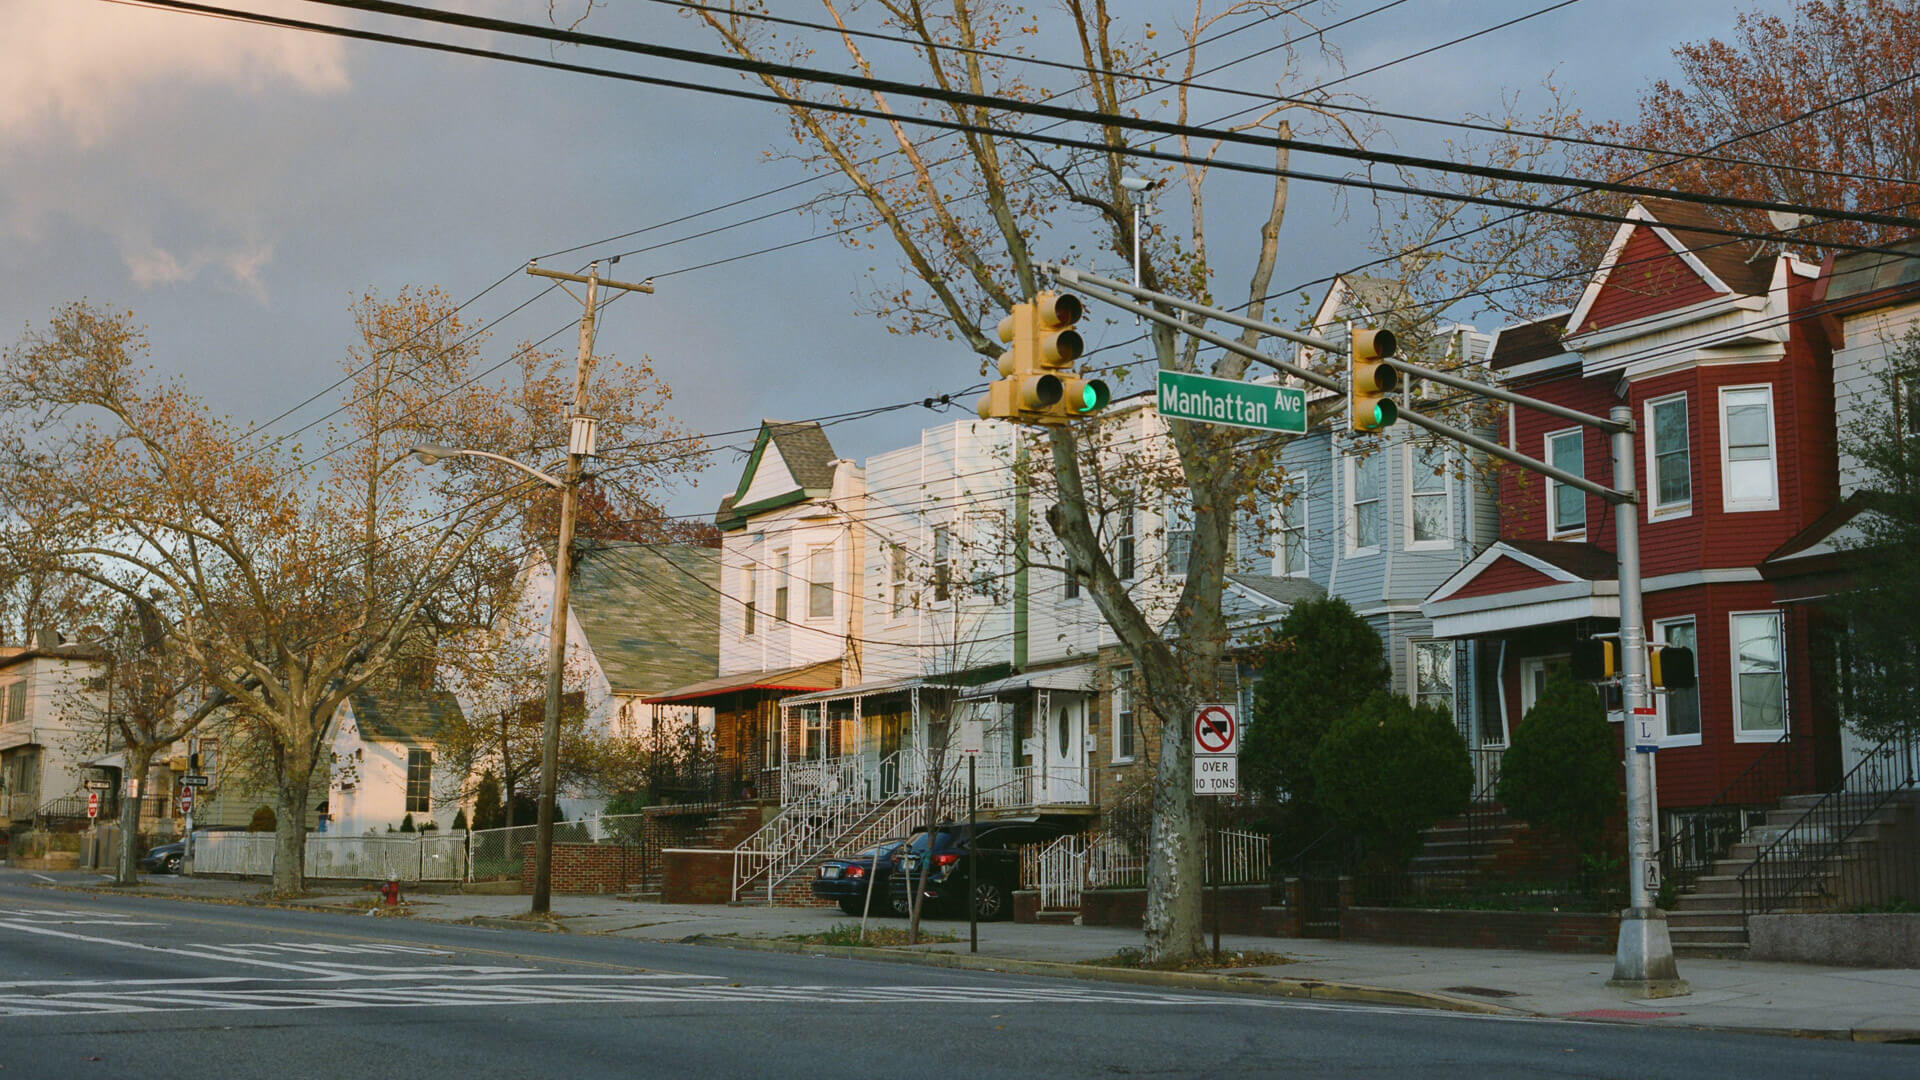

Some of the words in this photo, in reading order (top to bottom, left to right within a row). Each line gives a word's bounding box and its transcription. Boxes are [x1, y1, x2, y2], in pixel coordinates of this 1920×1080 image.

[1162, 383, 1267, 424] Manhattan
[1274, 390, 1301, 413] Ave
[1641, 721, 1651, 738] L
[1202, 762, 1228, 772] OVER
[1195, 778, 1205, 788] 10
[1211, 778, 1235, 788] TONS
